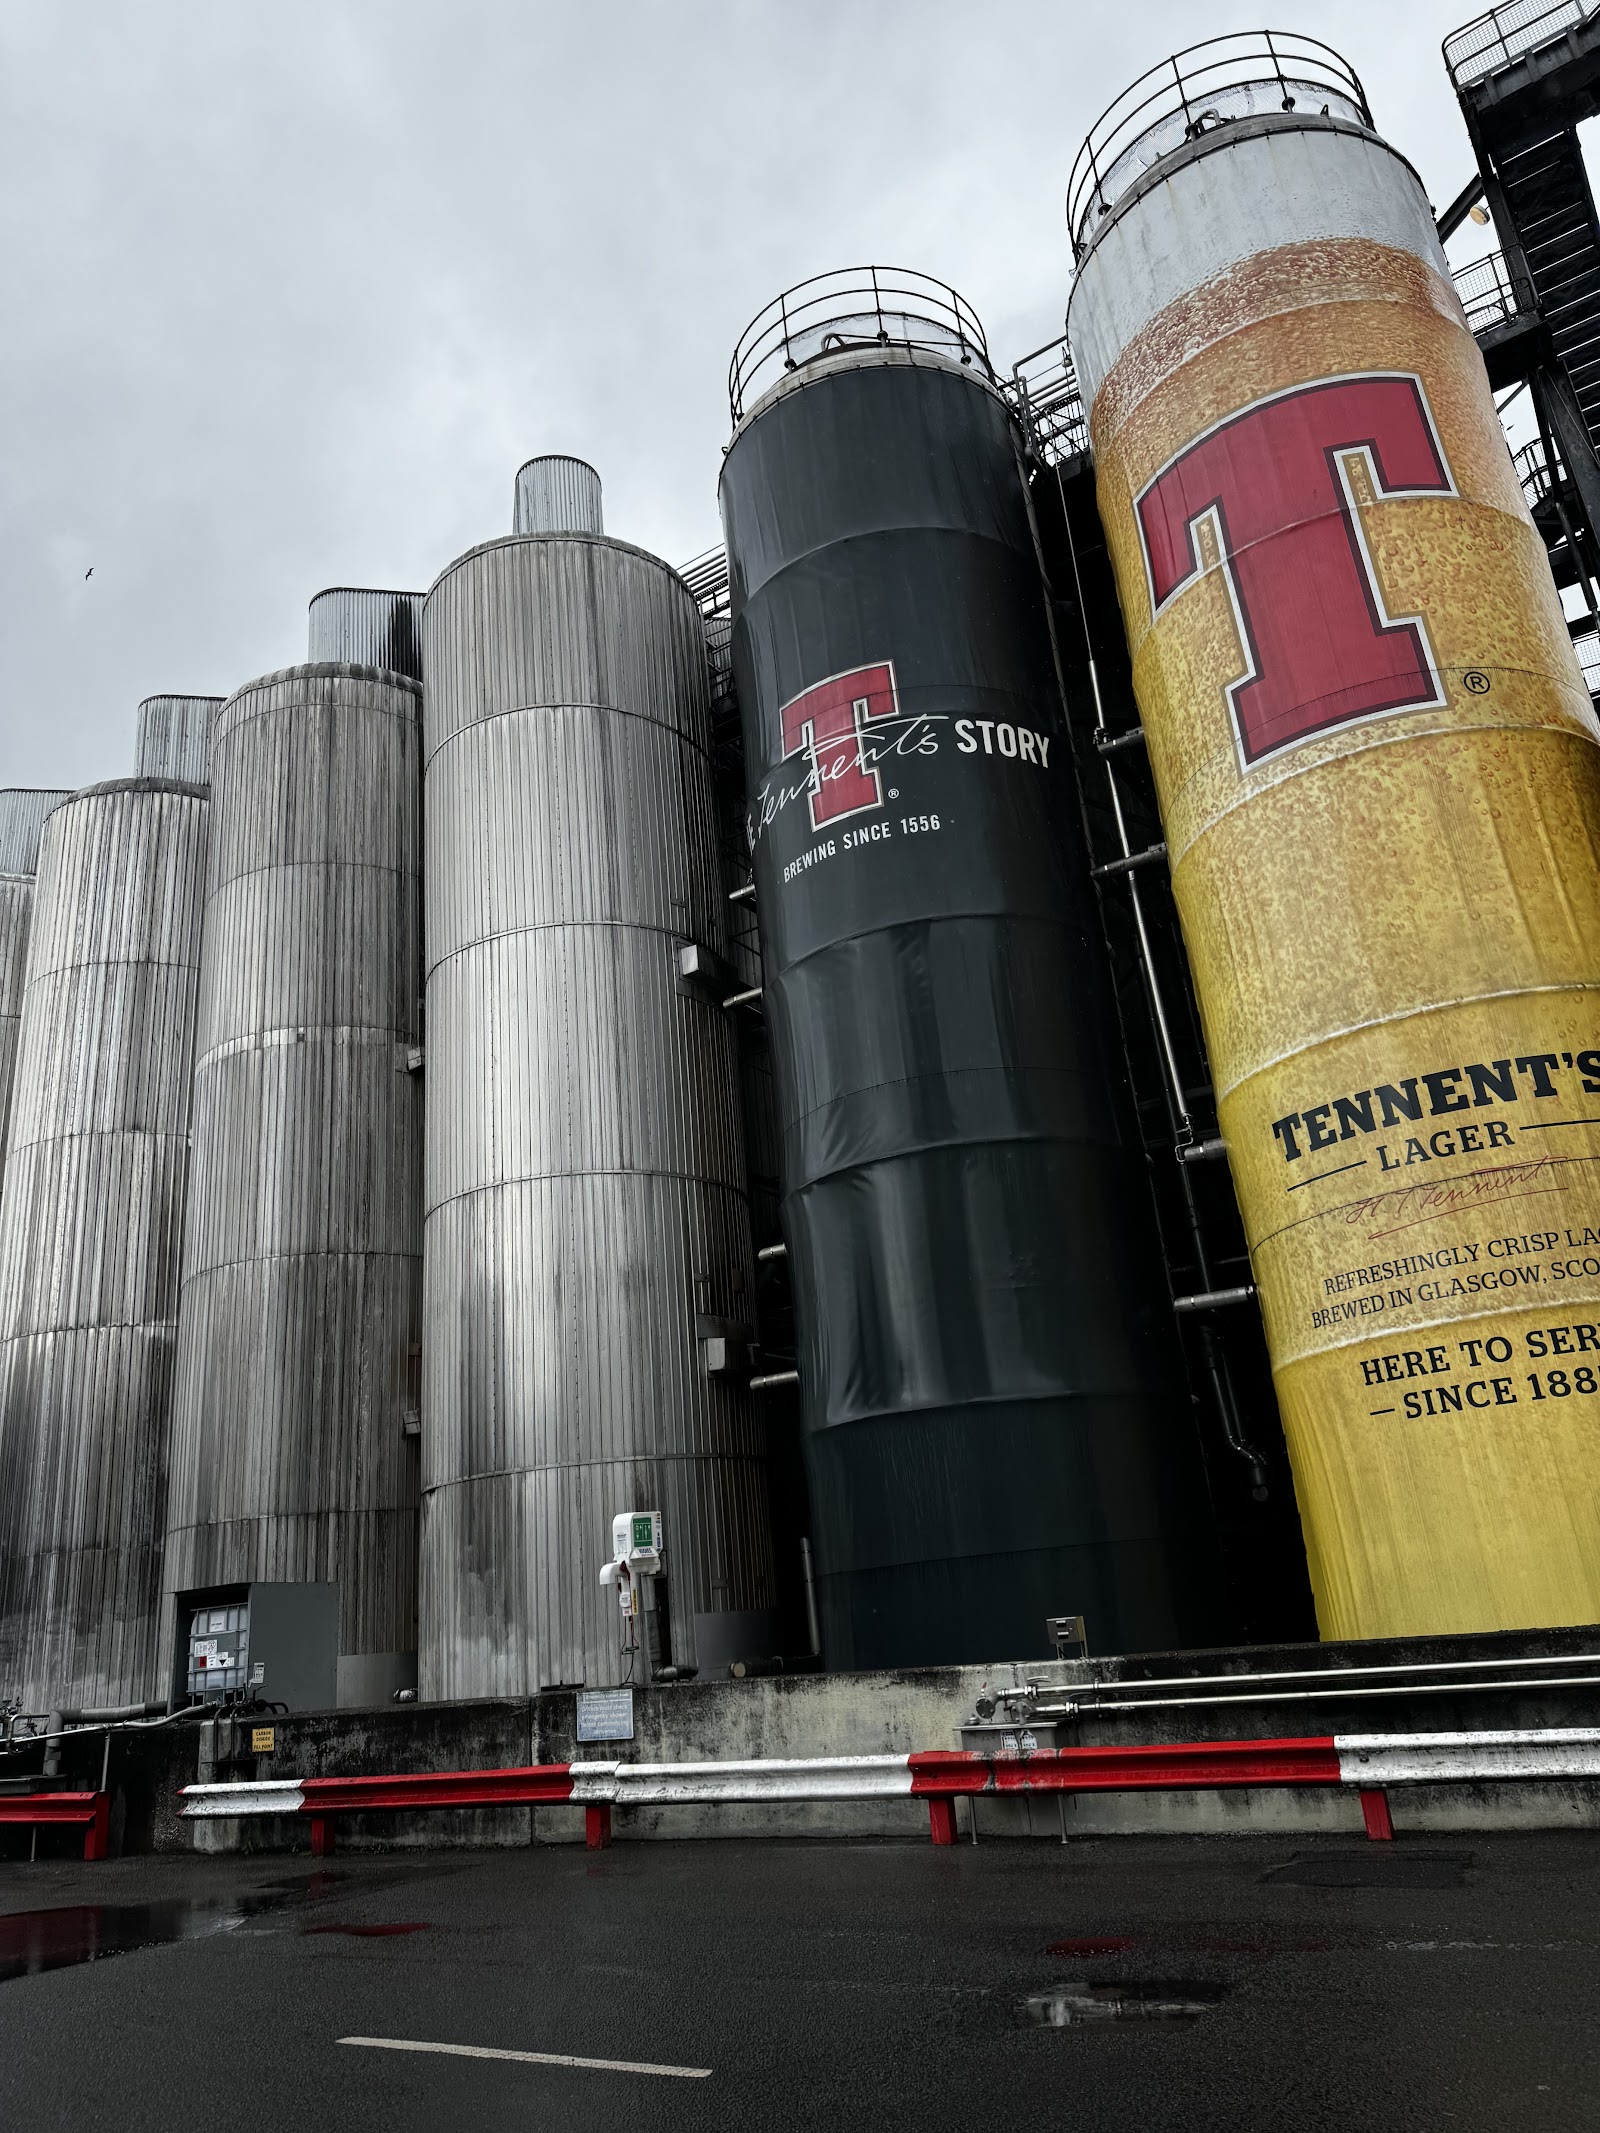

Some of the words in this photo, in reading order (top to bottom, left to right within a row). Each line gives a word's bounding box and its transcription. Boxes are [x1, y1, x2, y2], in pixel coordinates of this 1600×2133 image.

[1133, 371, 1460, 776] T
[954, 719, 1049, 768] STORY
[783, 840, 836, 883] BREWING
[843, 822, 891, 850] SINCE
[901, 814, 941, 834] 1556
[1272, 1050, 1600, 1162] TENNENT'S
[1376, 1121, 1515, 1171] LAGER
[1311, 1295, 1385, 1329] BREWED
[1390, 1287, 1412, 1309] IN
[1417, 1265, 1548, 1302] GLASGOW,
[1551, 1257, 1600, 1280] SCO
[1324, 1243, 1479, 1295] REFRESHINGLY
[1487, 1231, 1559, 1259] CRISP
[1564, 1227, 1600, 1247] LA
[1360, 1346, 1451, 1386] HERE
[1459, 1336, 1513, 1367] TO
[1525, 1323, 1600, 1358] SER
[1404, 1377, 1518, 1419] SINCE
[1527, 1366, 1600, 1400] 188
